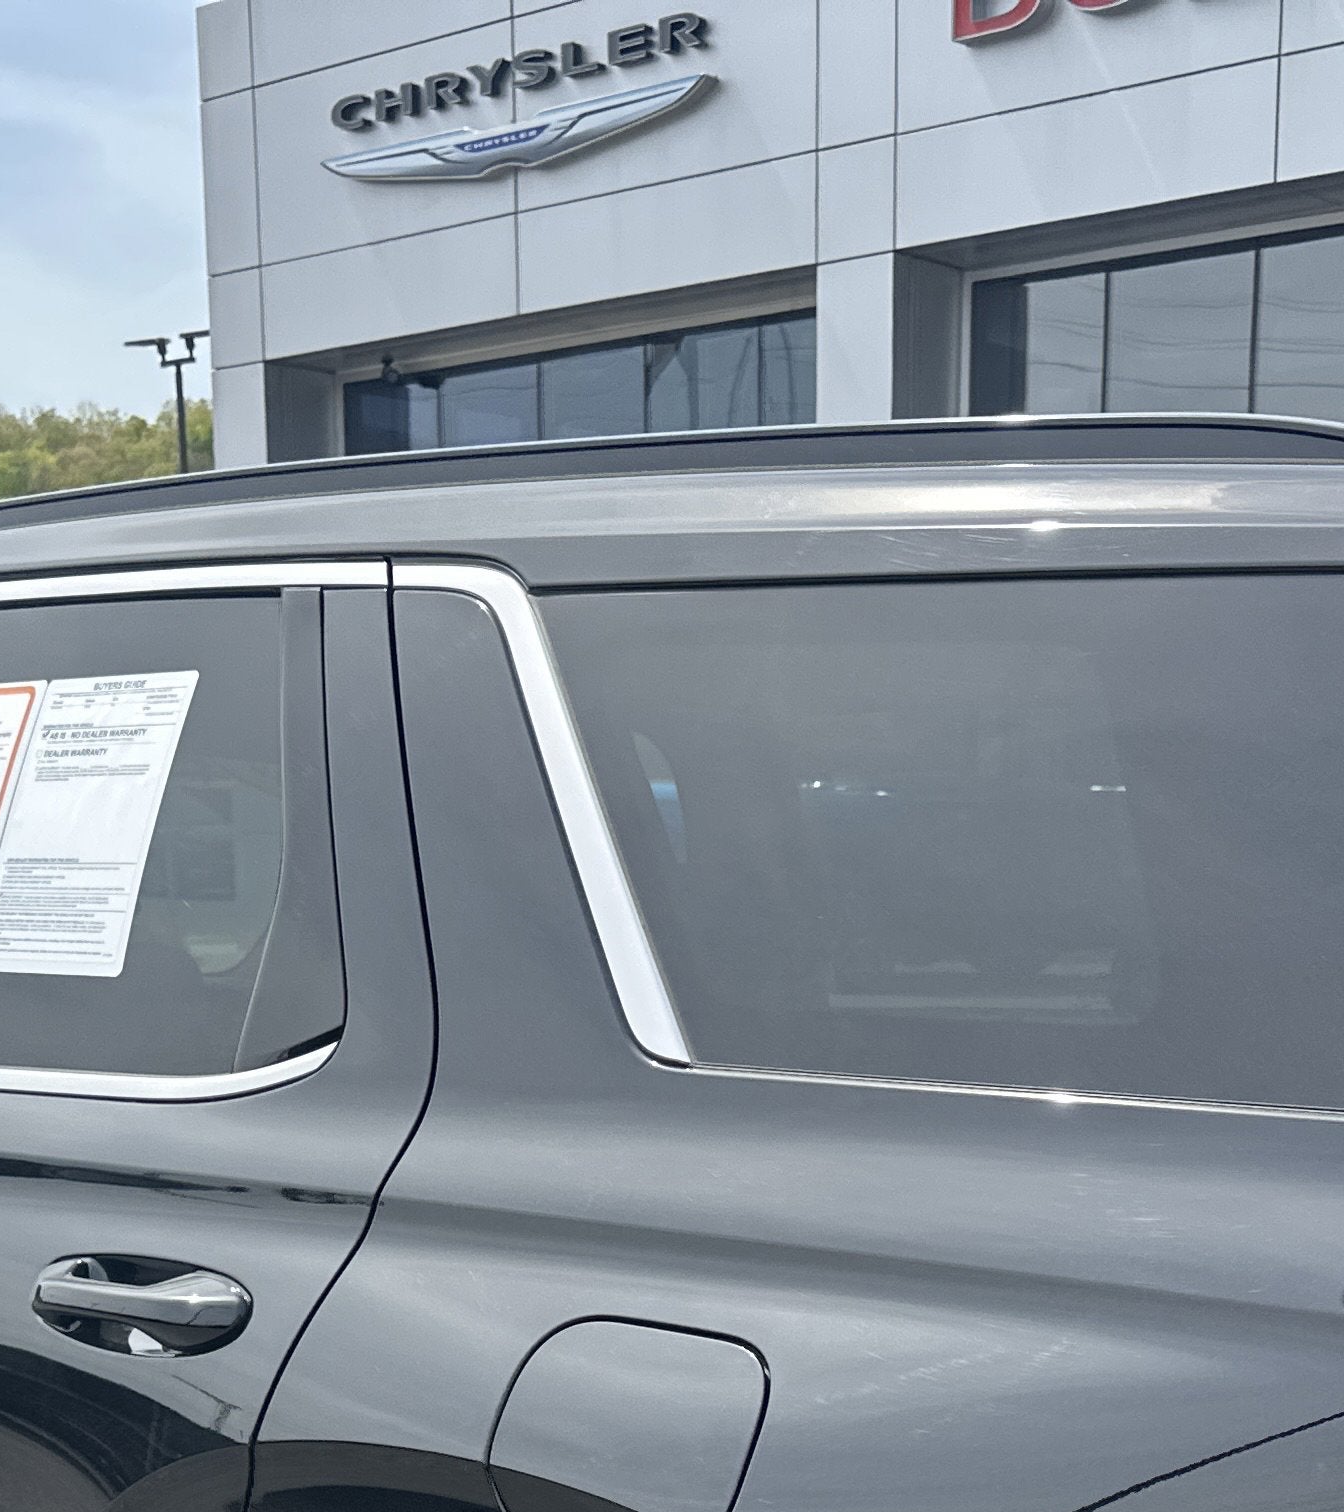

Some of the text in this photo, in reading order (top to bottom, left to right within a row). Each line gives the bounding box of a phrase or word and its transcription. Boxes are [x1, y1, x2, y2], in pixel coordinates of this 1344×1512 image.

[331, 12, 710, 132] CHRYSLER
[462, 129, 540, 152] CHRYSLER
[93, 680, 147, 691] BUYERS GUIDE
[71, 731, 80, 739] NO
[82, 730, 108, 739] DEALER
[109, 728, 147, 737] WARRANTY
[44, 748, 108, 758] DEALER WARRANTY
